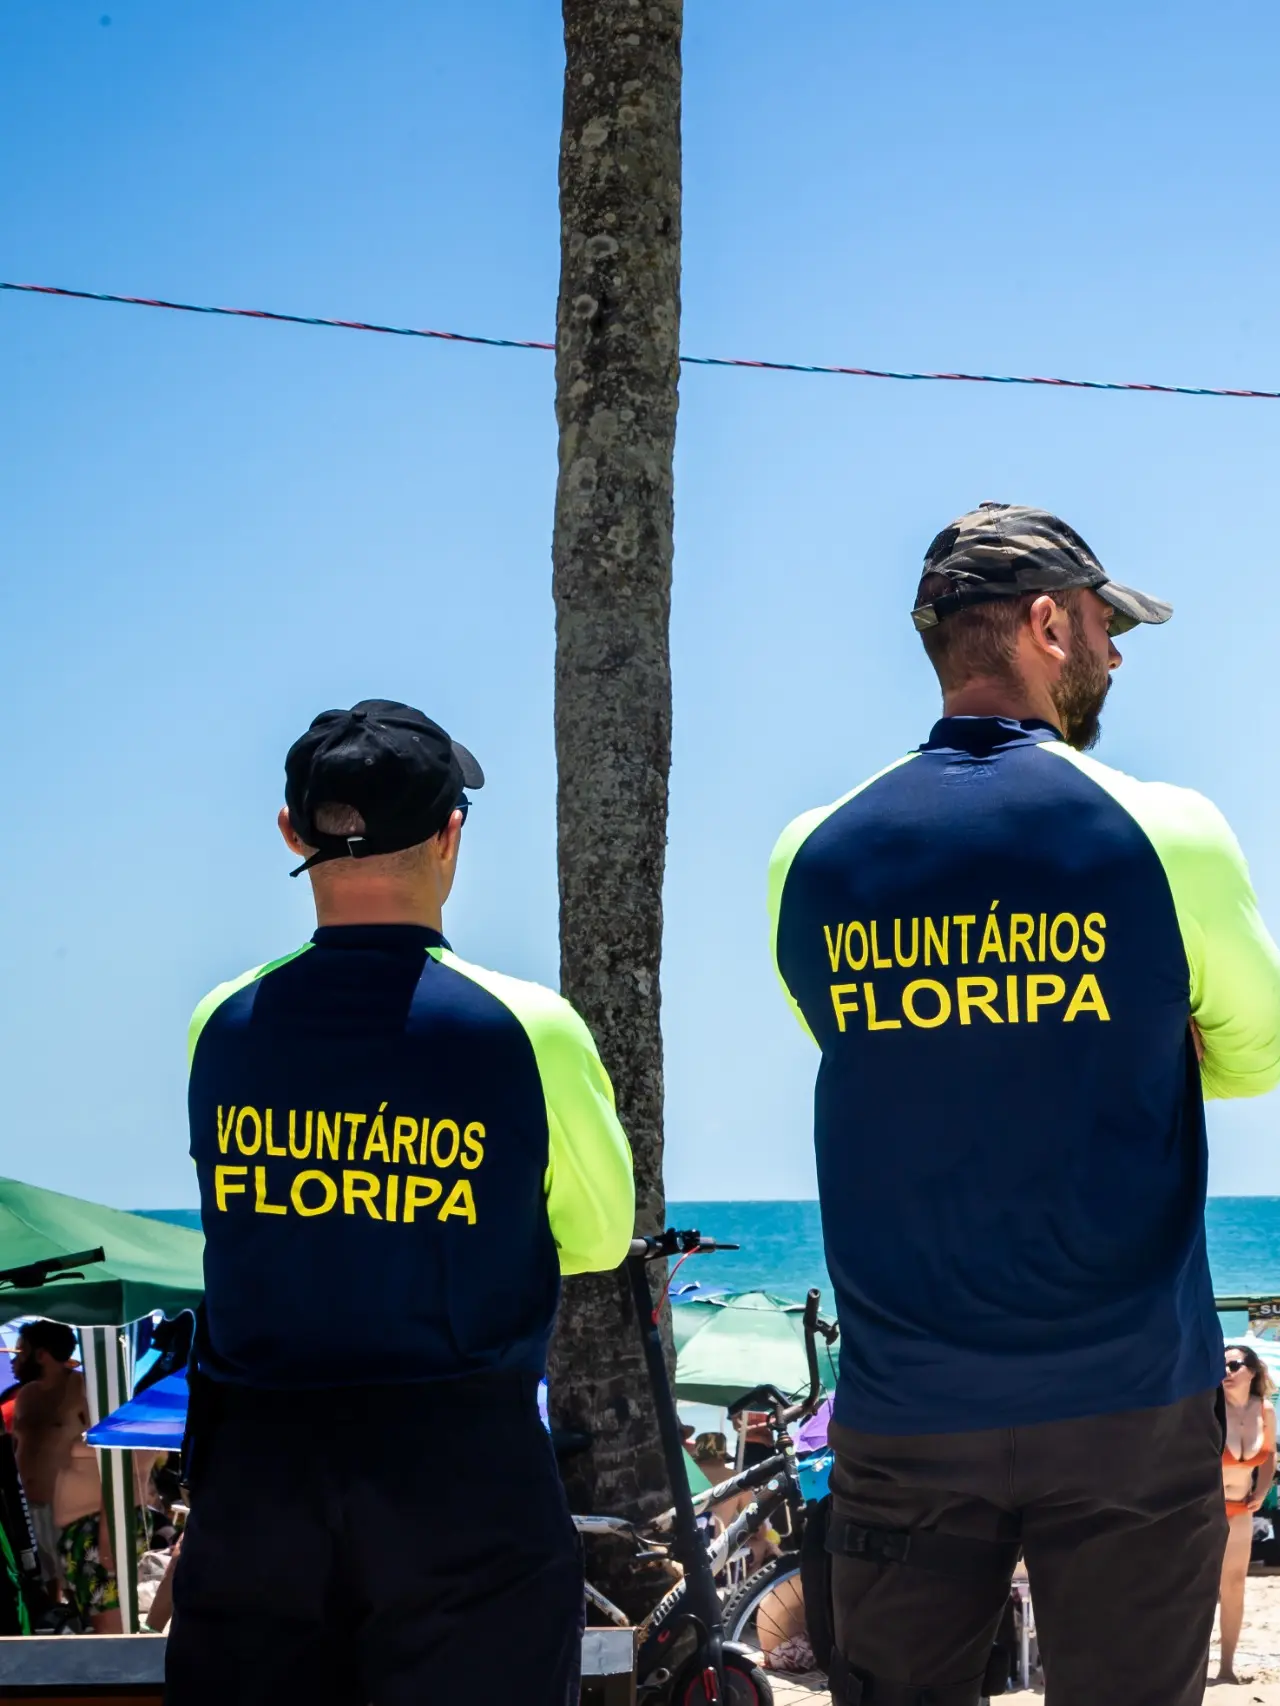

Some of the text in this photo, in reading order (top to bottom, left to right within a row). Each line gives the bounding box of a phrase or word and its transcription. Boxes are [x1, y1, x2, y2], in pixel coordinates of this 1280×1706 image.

[823, 900, 1107, 973] VOLUNTÁRIOS
[830, 973, 1111, 1032] FLORIPA
[216, 1101, 486, 1170] VOLUNTÁRIOS
[214, 1165, 477, 1225] FLORIPA
